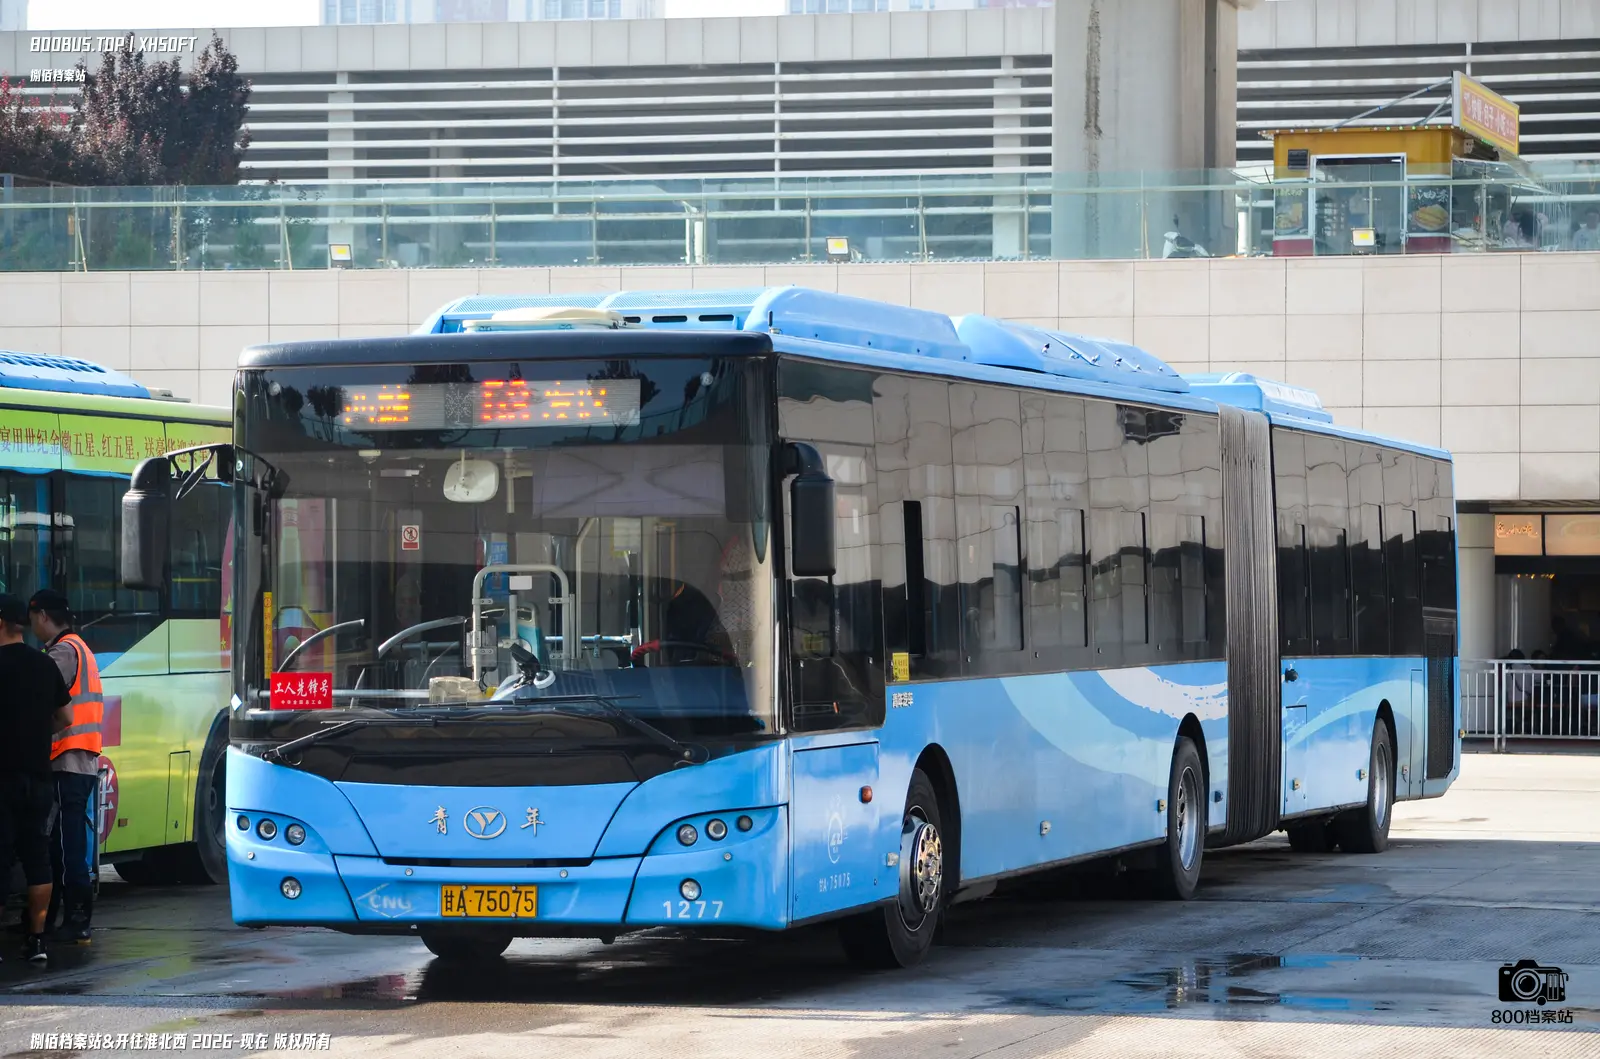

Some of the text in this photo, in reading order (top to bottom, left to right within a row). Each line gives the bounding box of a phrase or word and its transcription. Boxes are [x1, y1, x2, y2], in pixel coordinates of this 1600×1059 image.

[274, 678, 329, 698] 工人先锋号
[428, 806, 545, 837] 青 年
[368, 894, 412, 910] CNG
[662, 900, 724, 920] 1277
